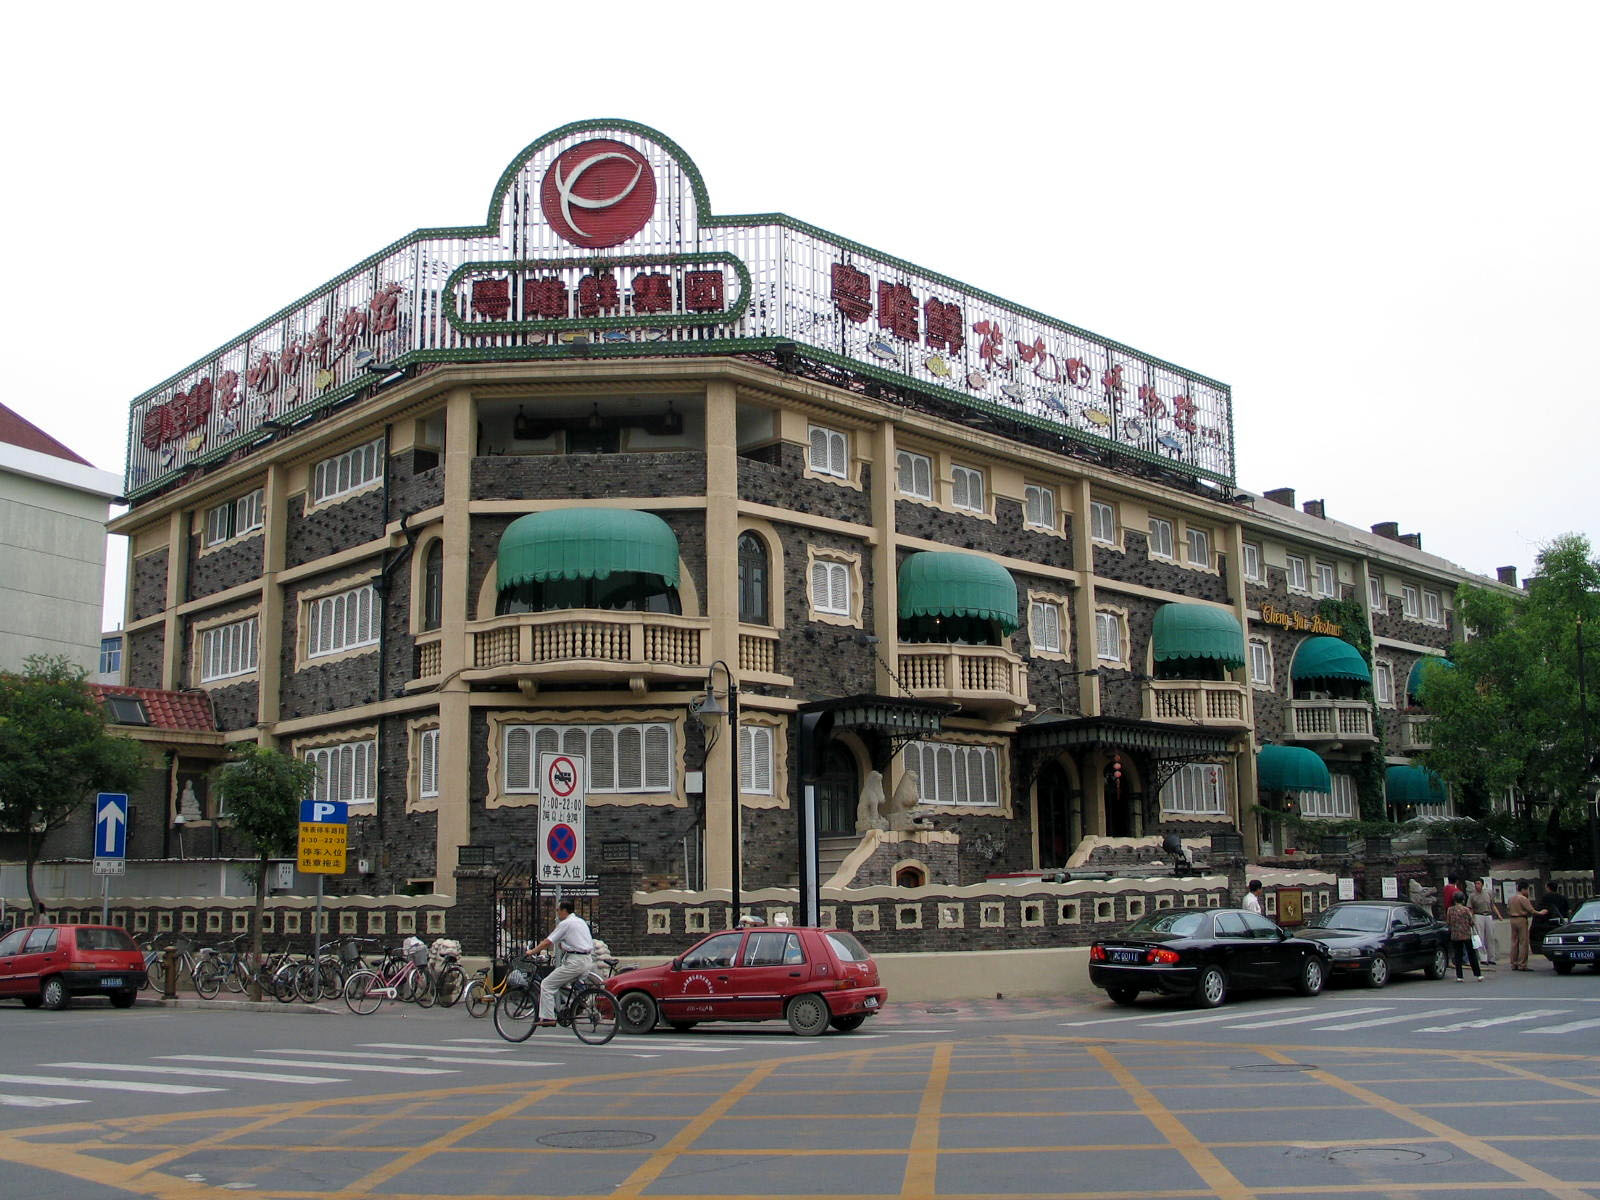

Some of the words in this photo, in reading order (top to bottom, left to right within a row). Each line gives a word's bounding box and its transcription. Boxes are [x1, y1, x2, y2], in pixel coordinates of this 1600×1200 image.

[543, 797, 582, 811] 7:00-22:00
[313, 802, 335, 821] P
[303, 848, 343, 857] 停车入位
[543, 864, 581, 878] 停车入位
